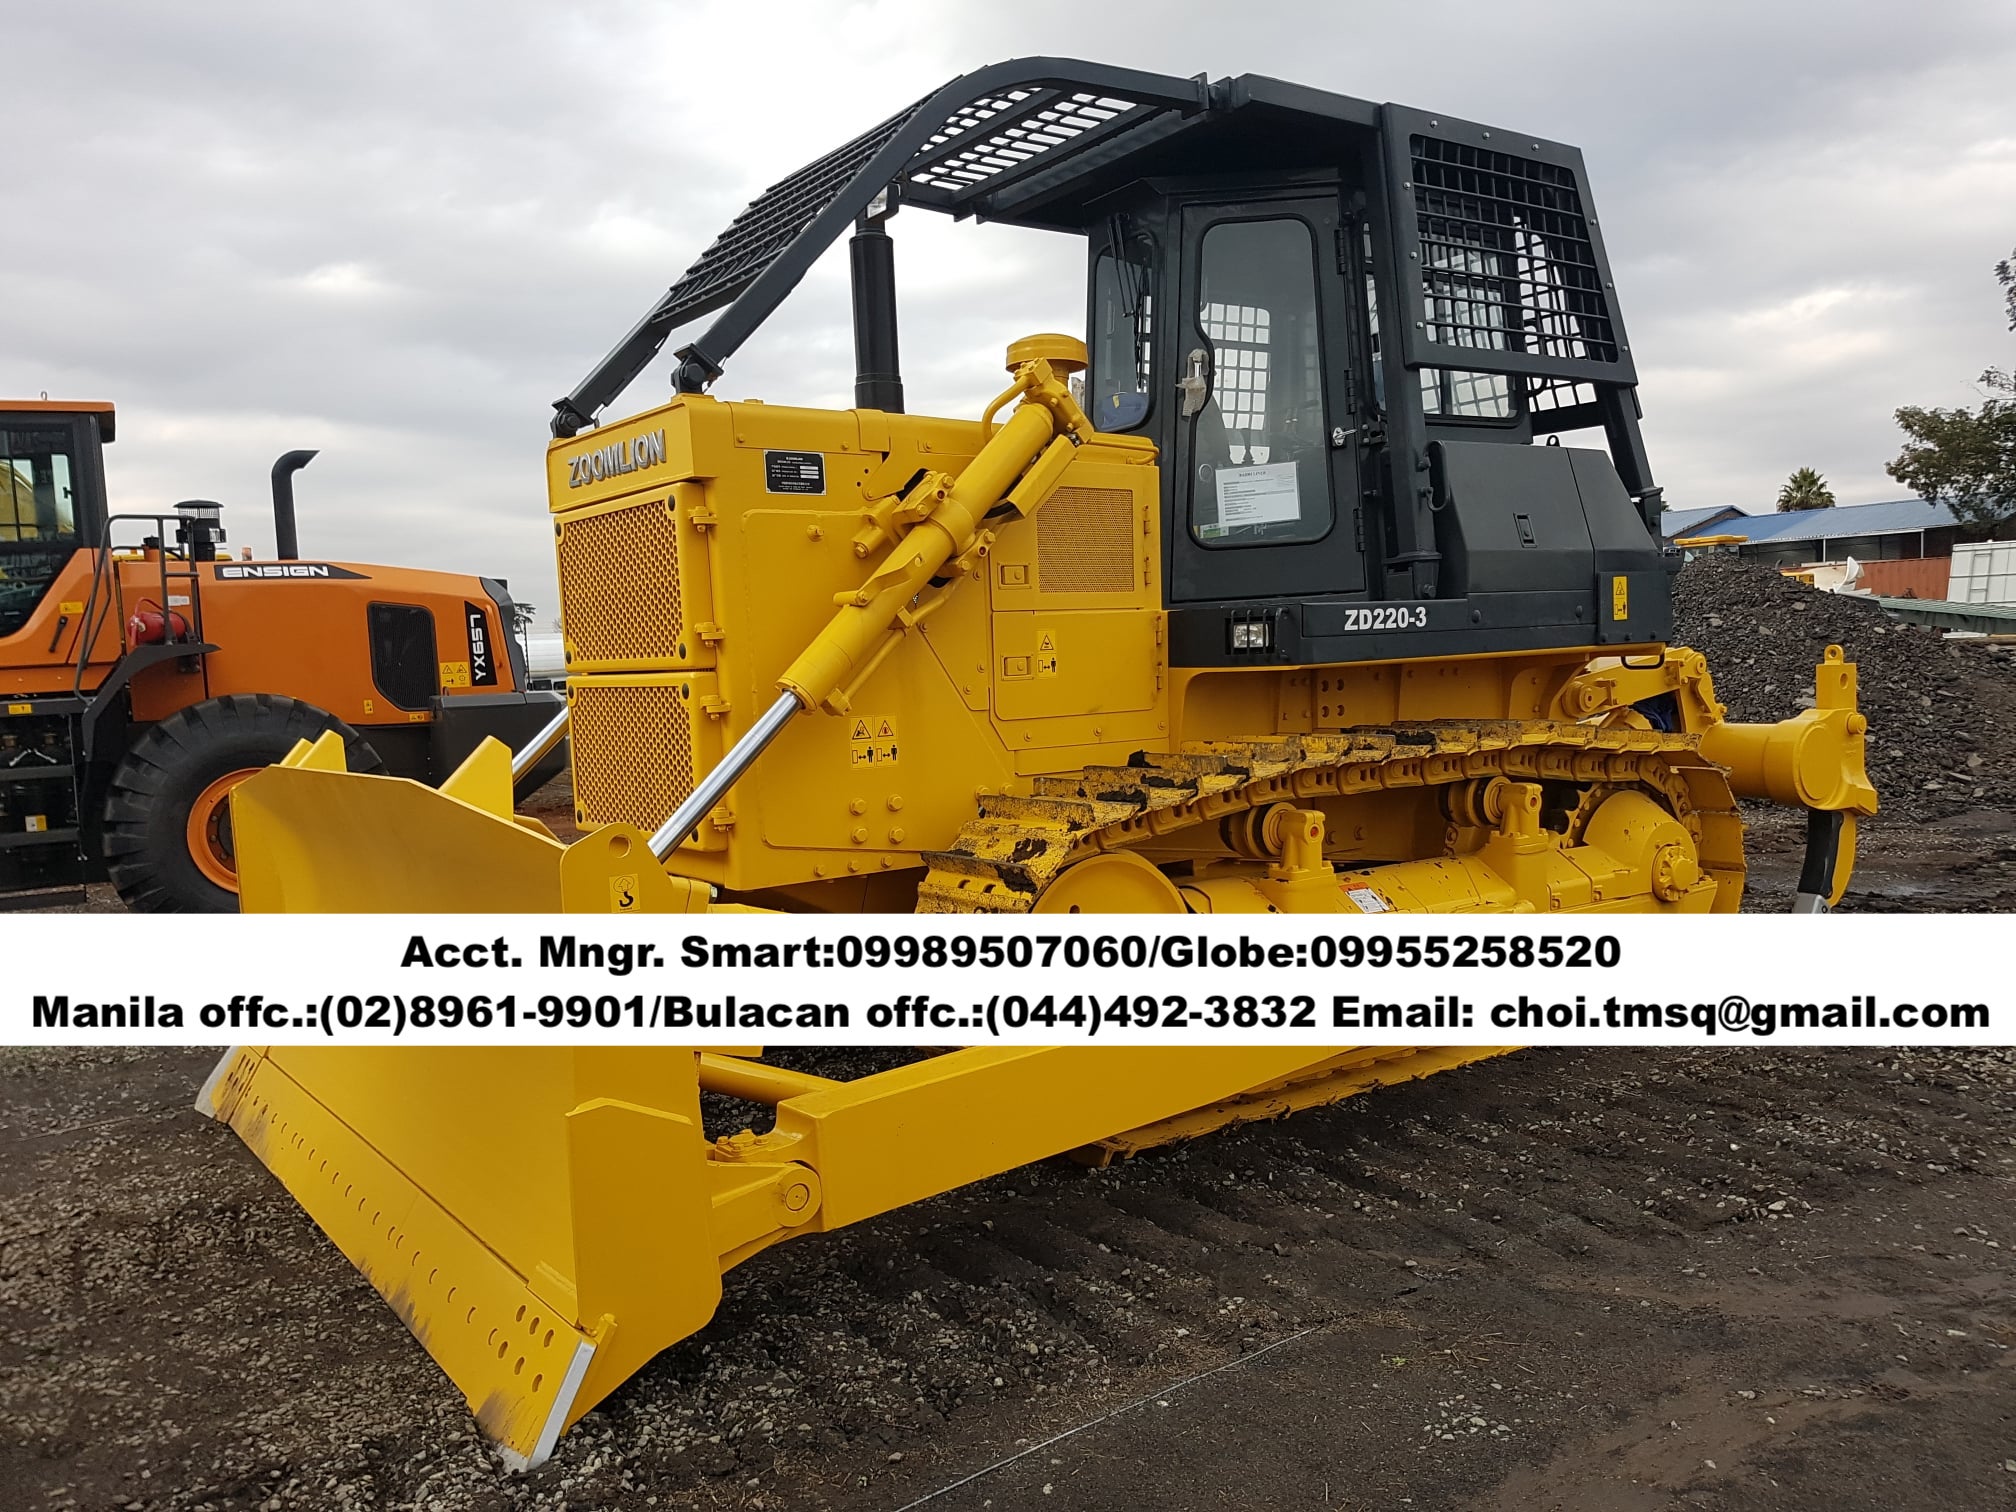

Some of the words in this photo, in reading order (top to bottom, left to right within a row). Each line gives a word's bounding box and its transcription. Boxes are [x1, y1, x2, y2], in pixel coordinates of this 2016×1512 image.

[568, 428, 667, 488] ZOOMLION
[222, 566, 329, 578] ENSIGN
[1344, 606, 1427, 631] ZD220-3
[469, 614, 487, 681] YX657
